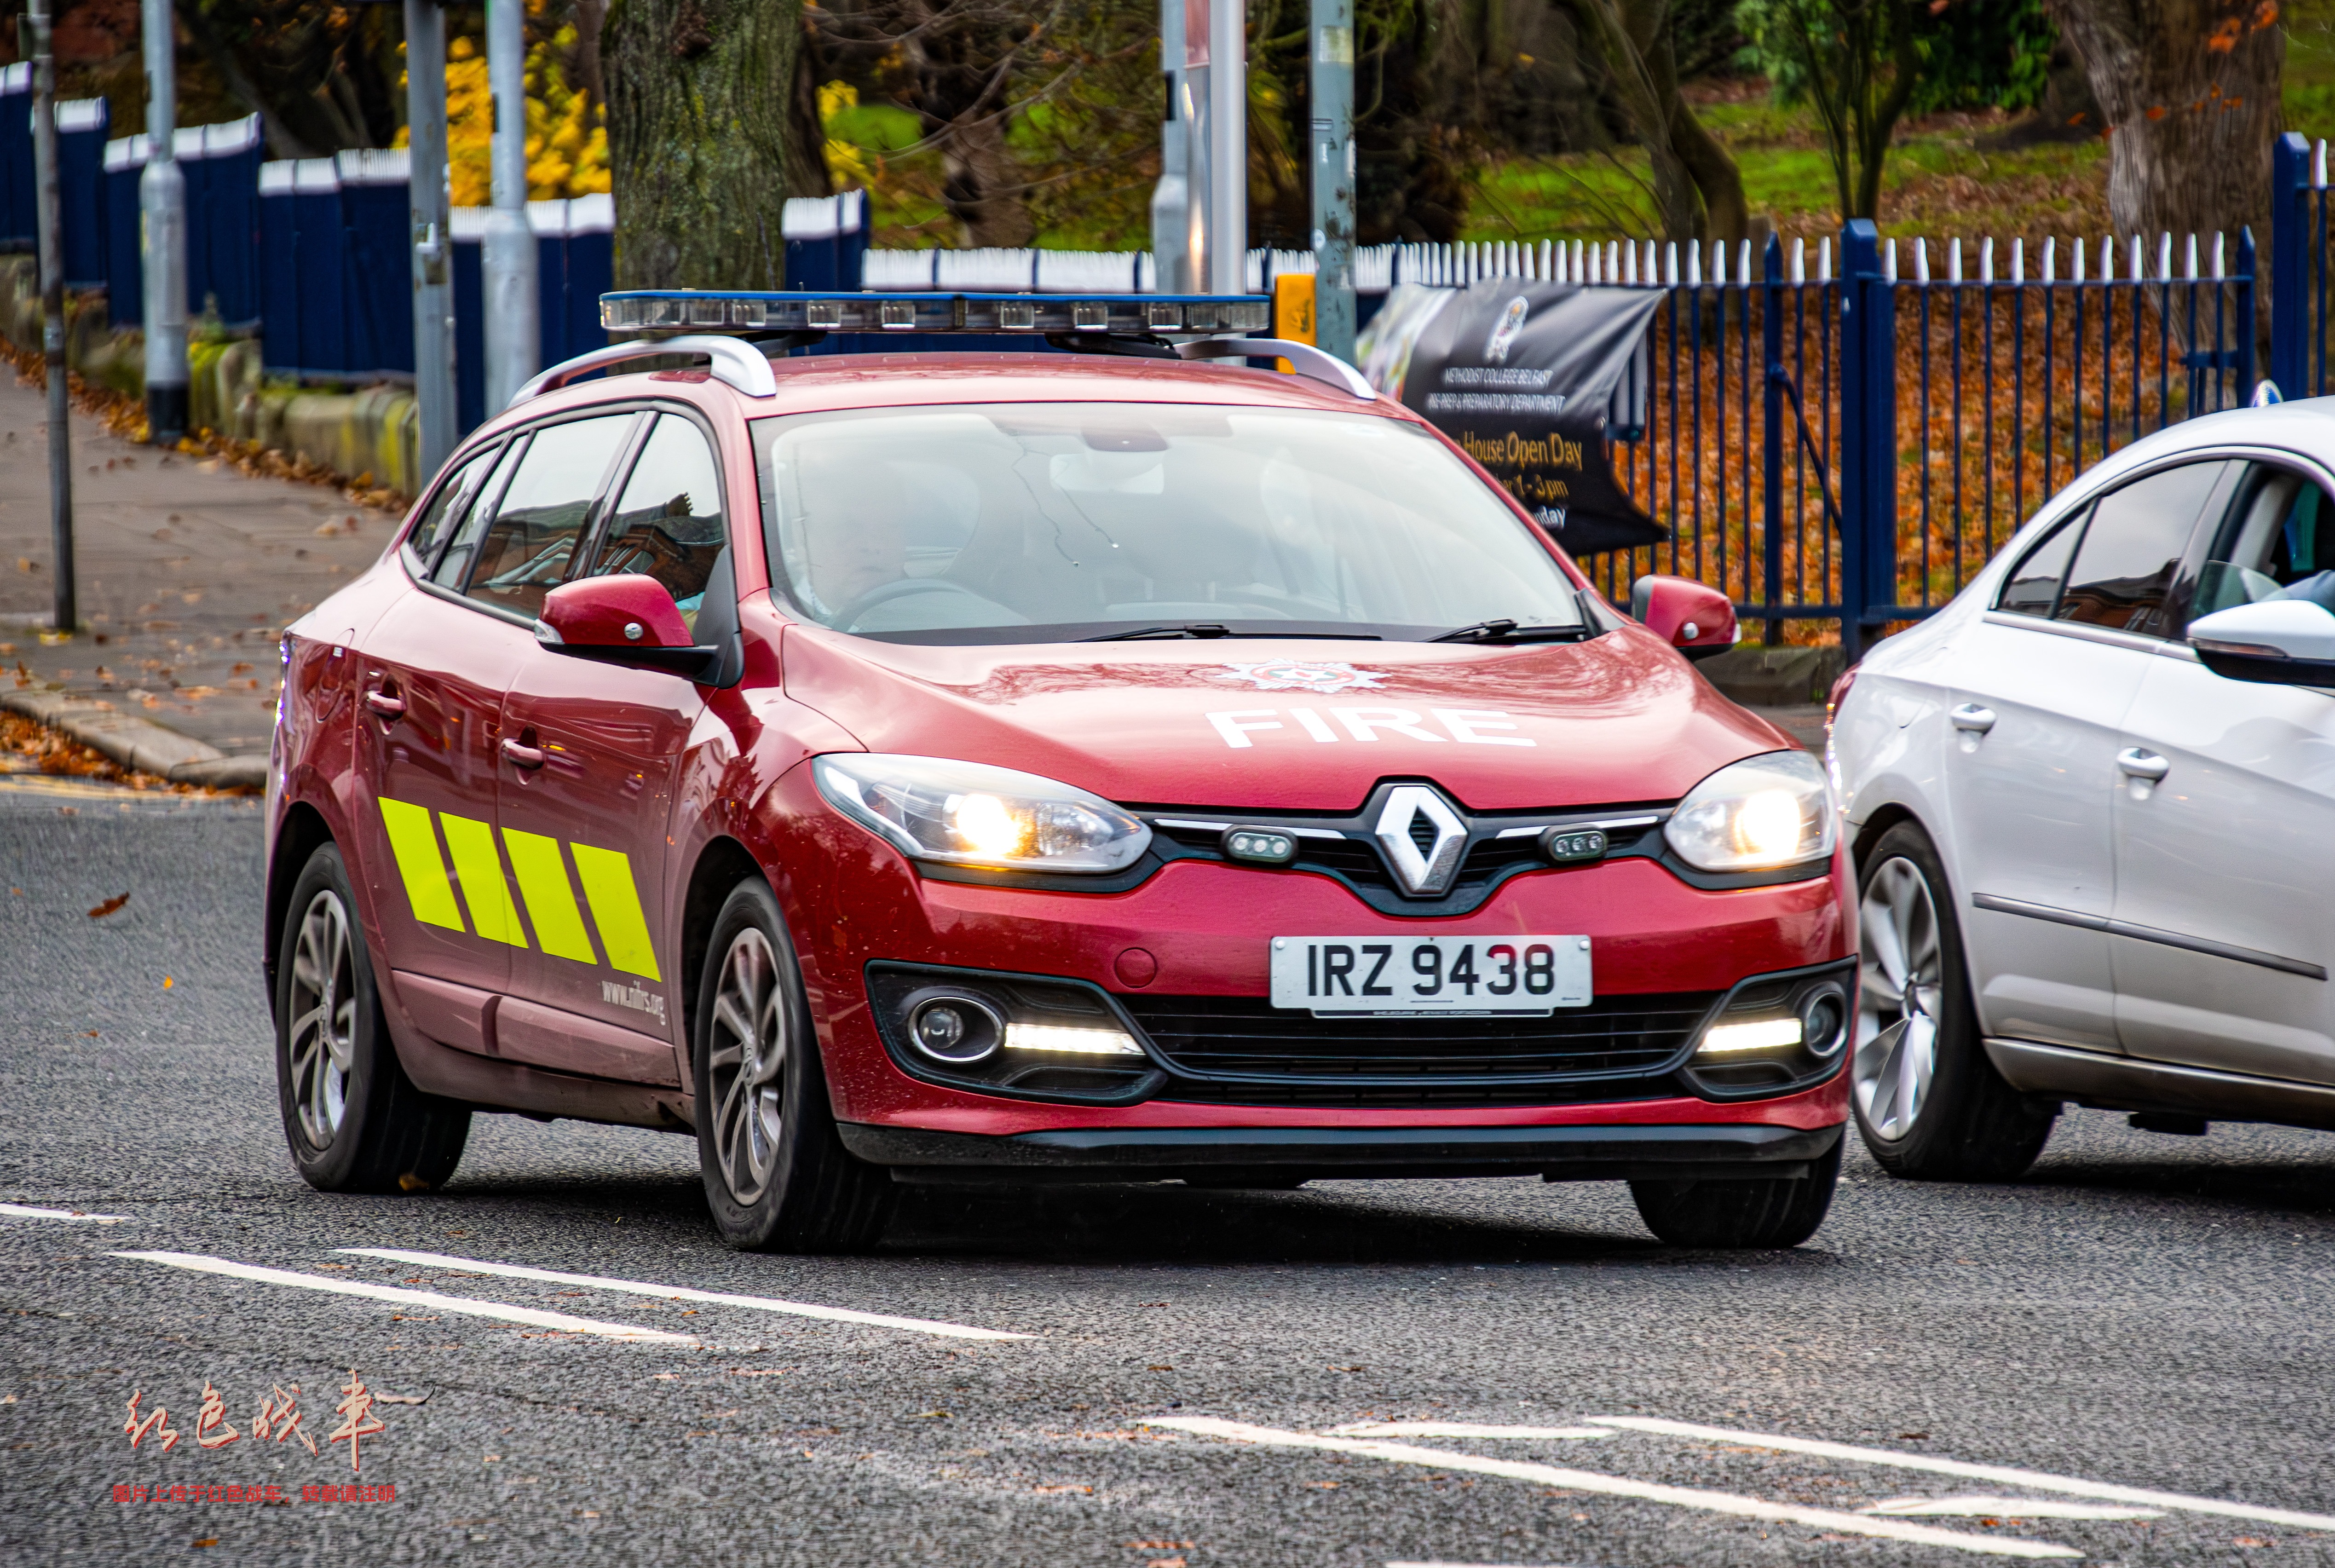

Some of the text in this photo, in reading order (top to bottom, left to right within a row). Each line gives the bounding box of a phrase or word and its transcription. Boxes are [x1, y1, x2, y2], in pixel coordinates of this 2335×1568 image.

[1464, 430, 1583, 472] House Open Day
[1205, 707, 1538, 748] FIRE
[1308, 944, 1555, 997] IRZ 9438
